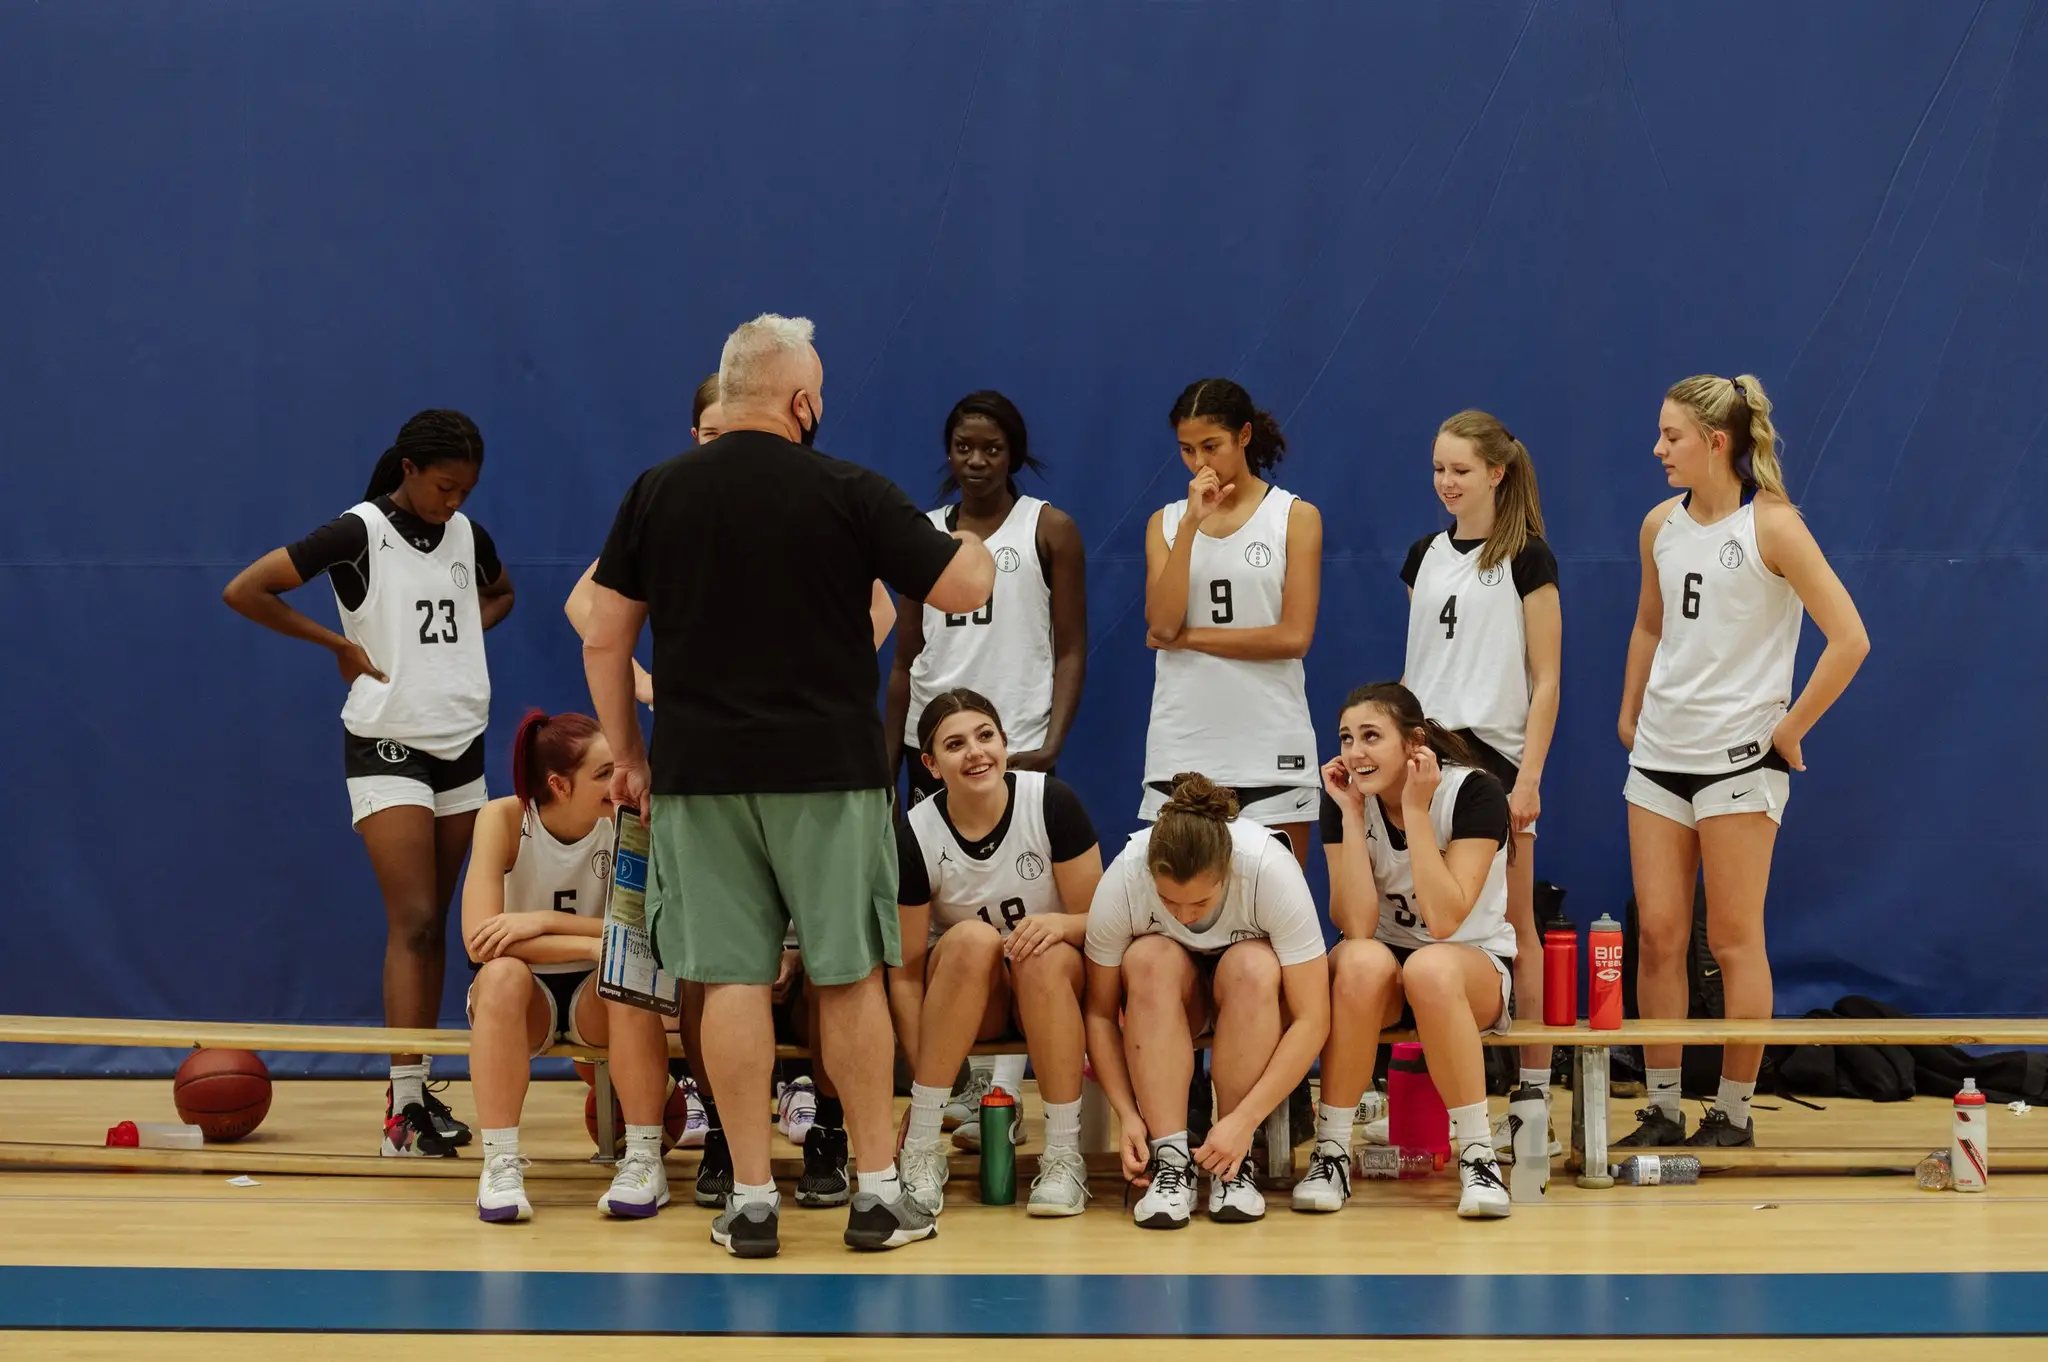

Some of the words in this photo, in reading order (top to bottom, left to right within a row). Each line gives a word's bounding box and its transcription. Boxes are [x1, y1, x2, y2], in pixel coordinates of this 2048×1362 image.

[1210, 579, 1233, 624] 9
[1439, 595, 1457, 639] 4
[1683, 572, 1702, 620] 6
[416, 600, 458, 644] 23
[1385, 892, 1428, 929] 3
[1595, 946, 1622, 960] BIO
[1359, 1103, 1367, 1121] ZERO
